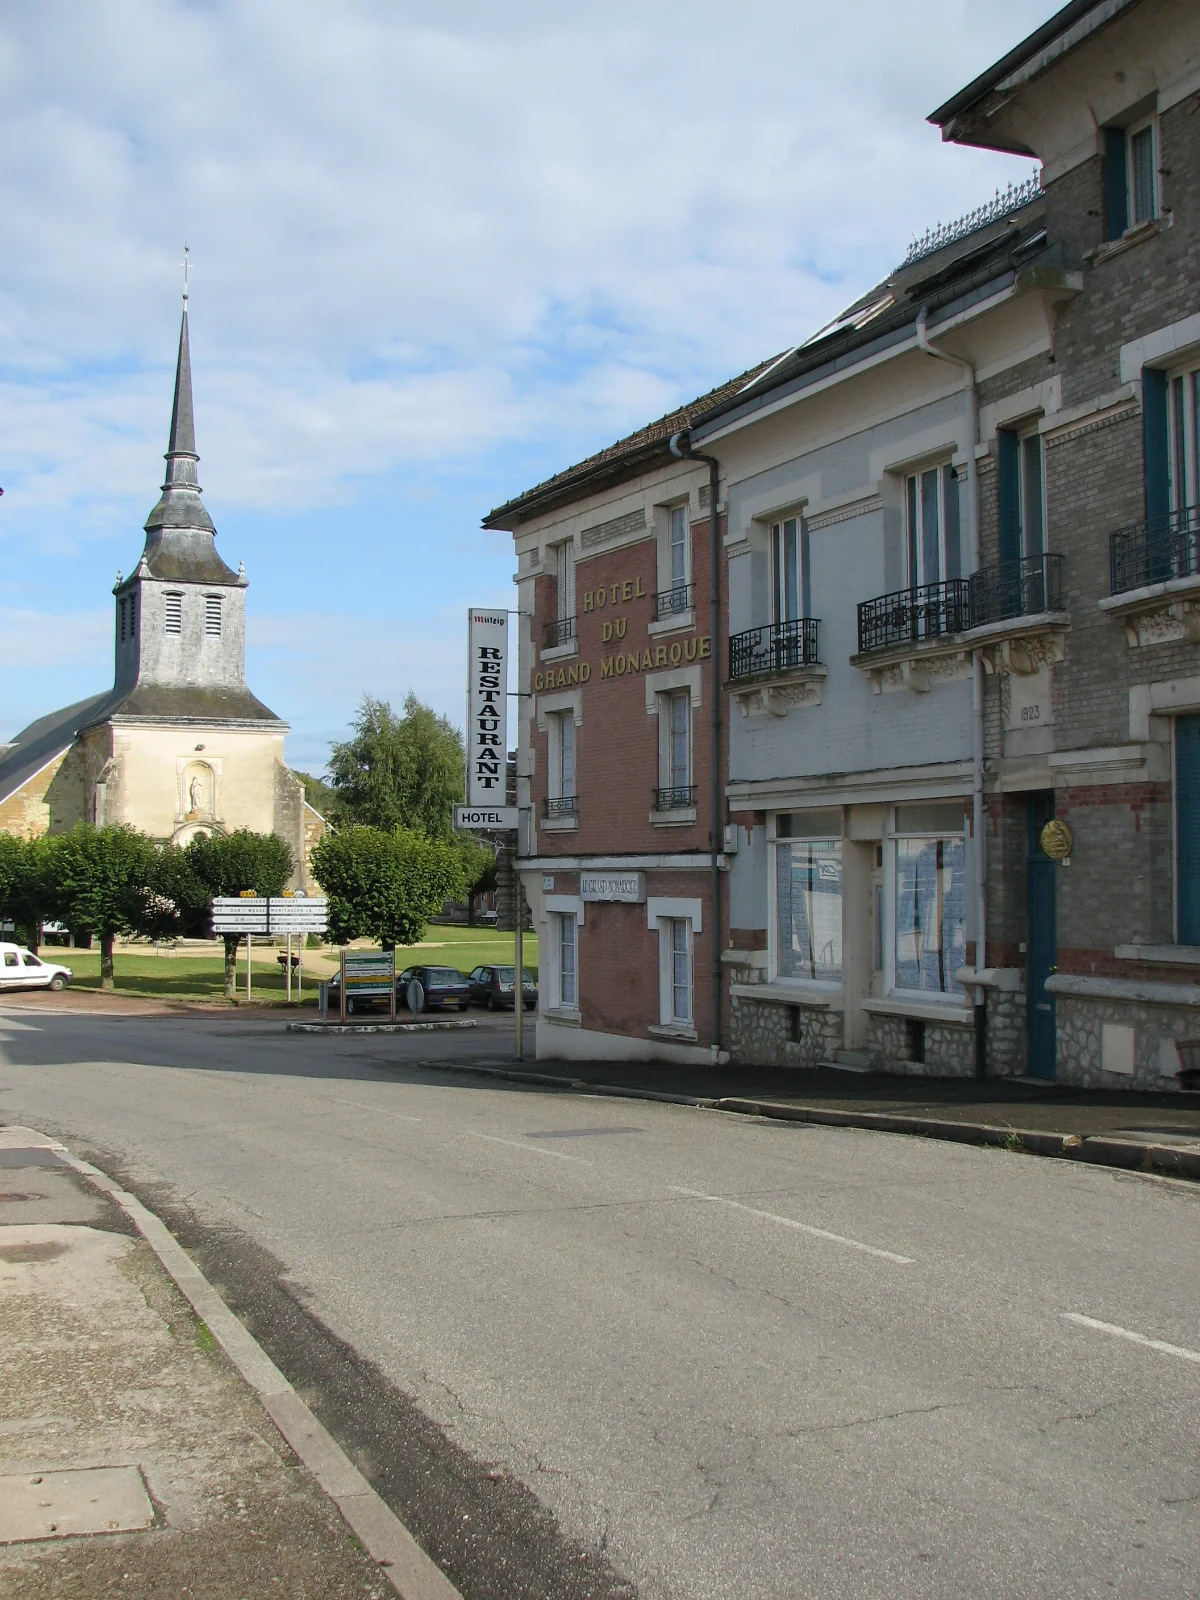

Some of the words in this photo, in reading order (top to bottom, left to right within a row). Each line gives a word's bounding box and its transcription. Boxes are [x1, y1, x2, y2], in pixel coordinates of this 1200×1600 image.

[583, 577, 647, 612] HÔTEL
[602, 617, 628, 643] DU
[535, 662, 592, 691] GRAND
[600, 635, 712, 680] MONARQUE
[476, 646, 503, 789] RESTAURANT
[1020, 704, 1041, 721] 1923
[462, 813, 502, 823] HOTEL
